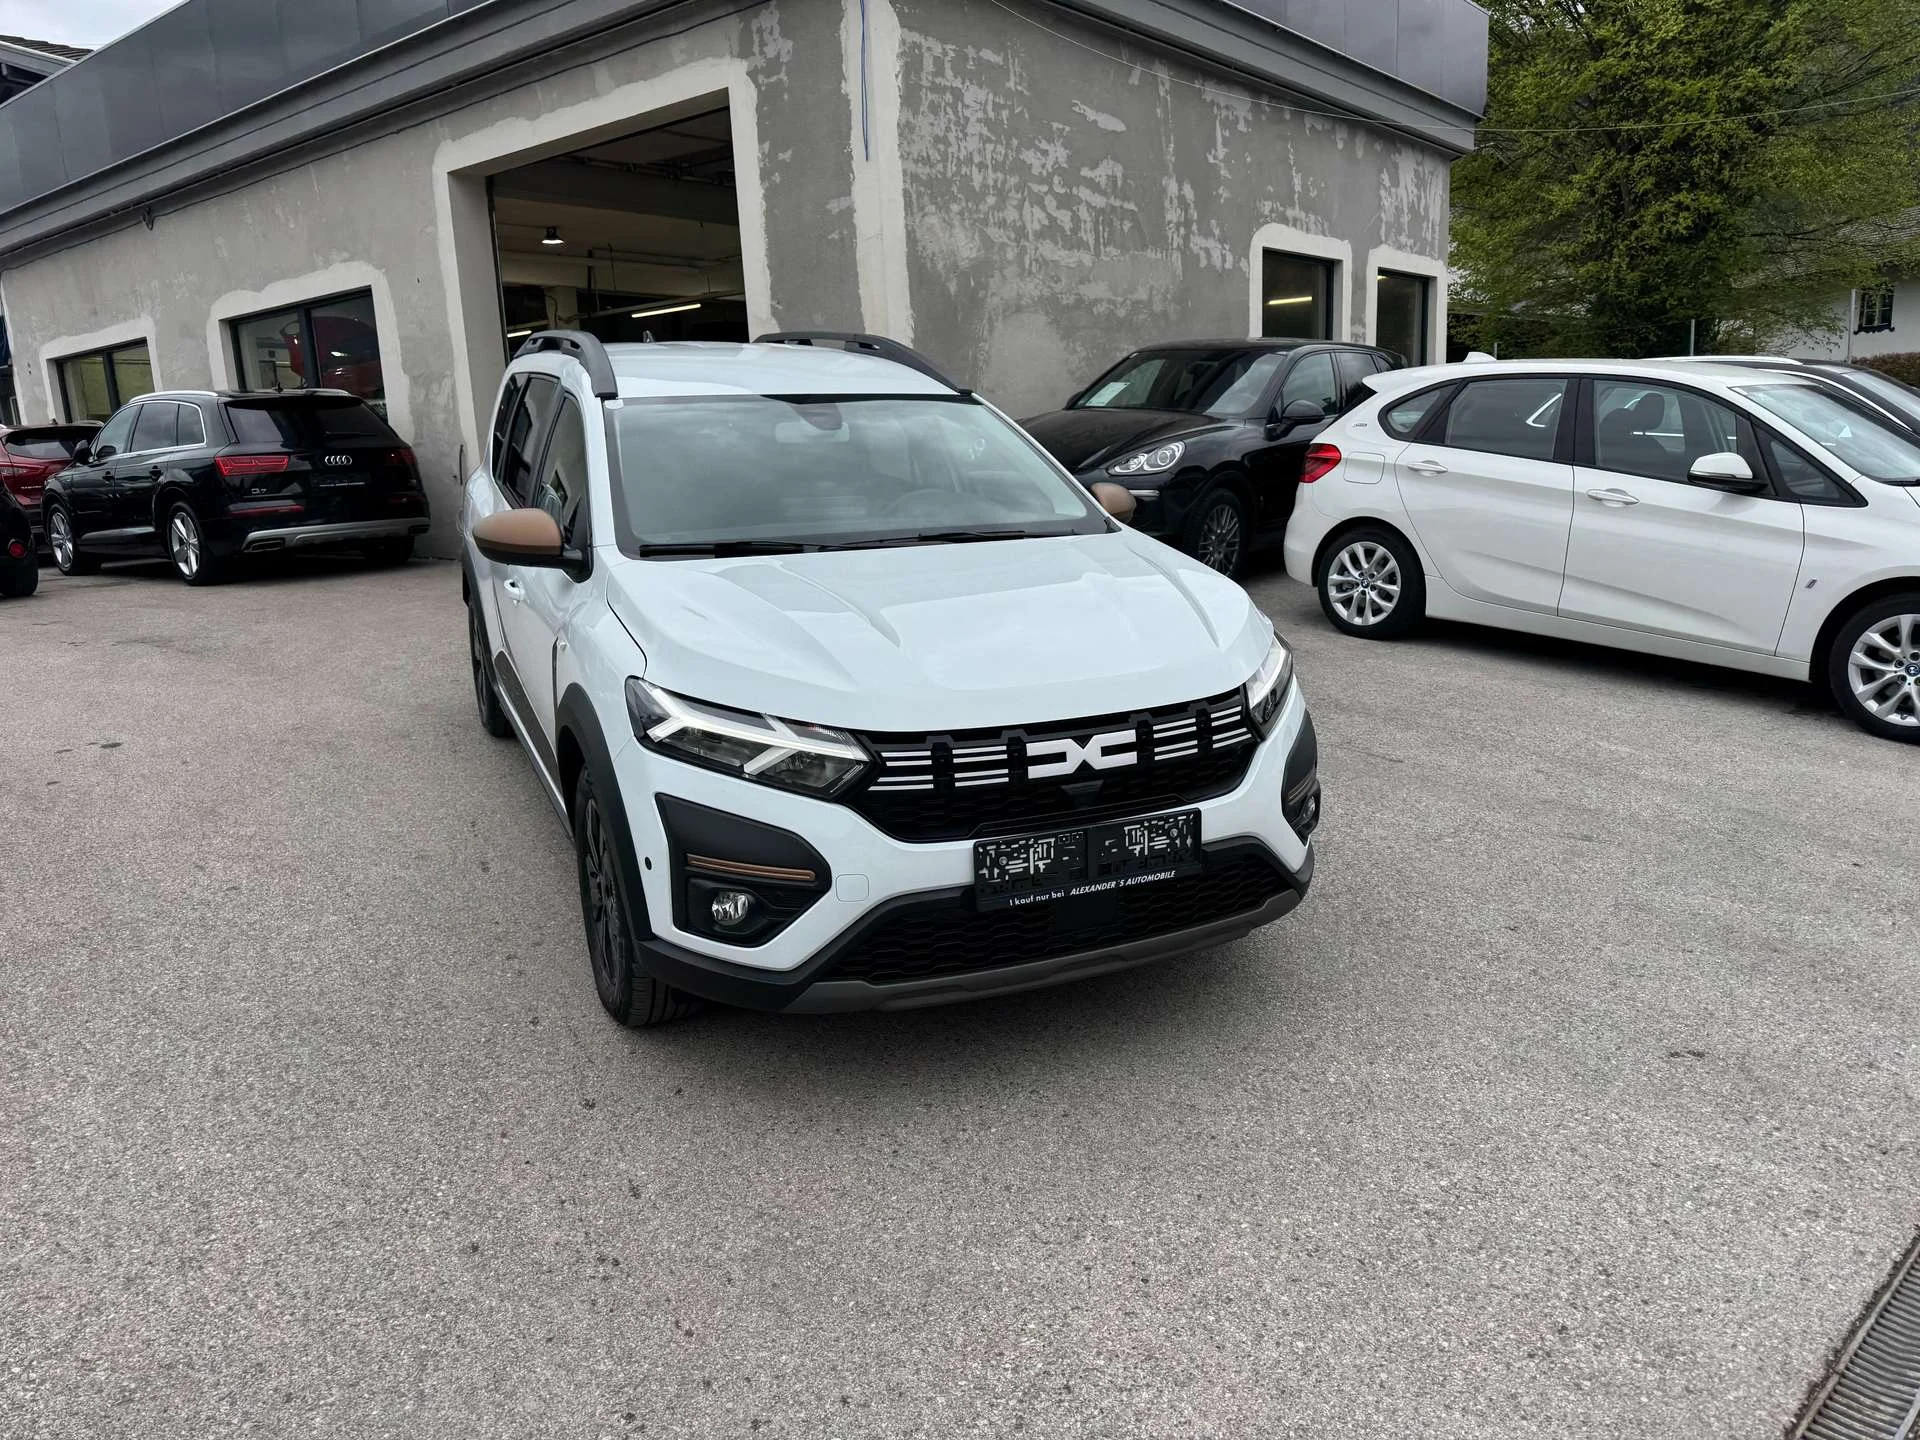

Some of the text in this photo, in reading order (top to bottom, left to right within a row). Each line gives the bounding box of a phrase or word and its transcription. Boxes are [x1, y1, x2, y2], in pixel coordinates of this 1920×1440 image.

[1015, 895, 1034, 906] kauf
[1036, 893, 1050, 902] nur
[1051, 889, 1065, 899] bei
[1126, 870, 1176, 887] AUTOMOBILE
